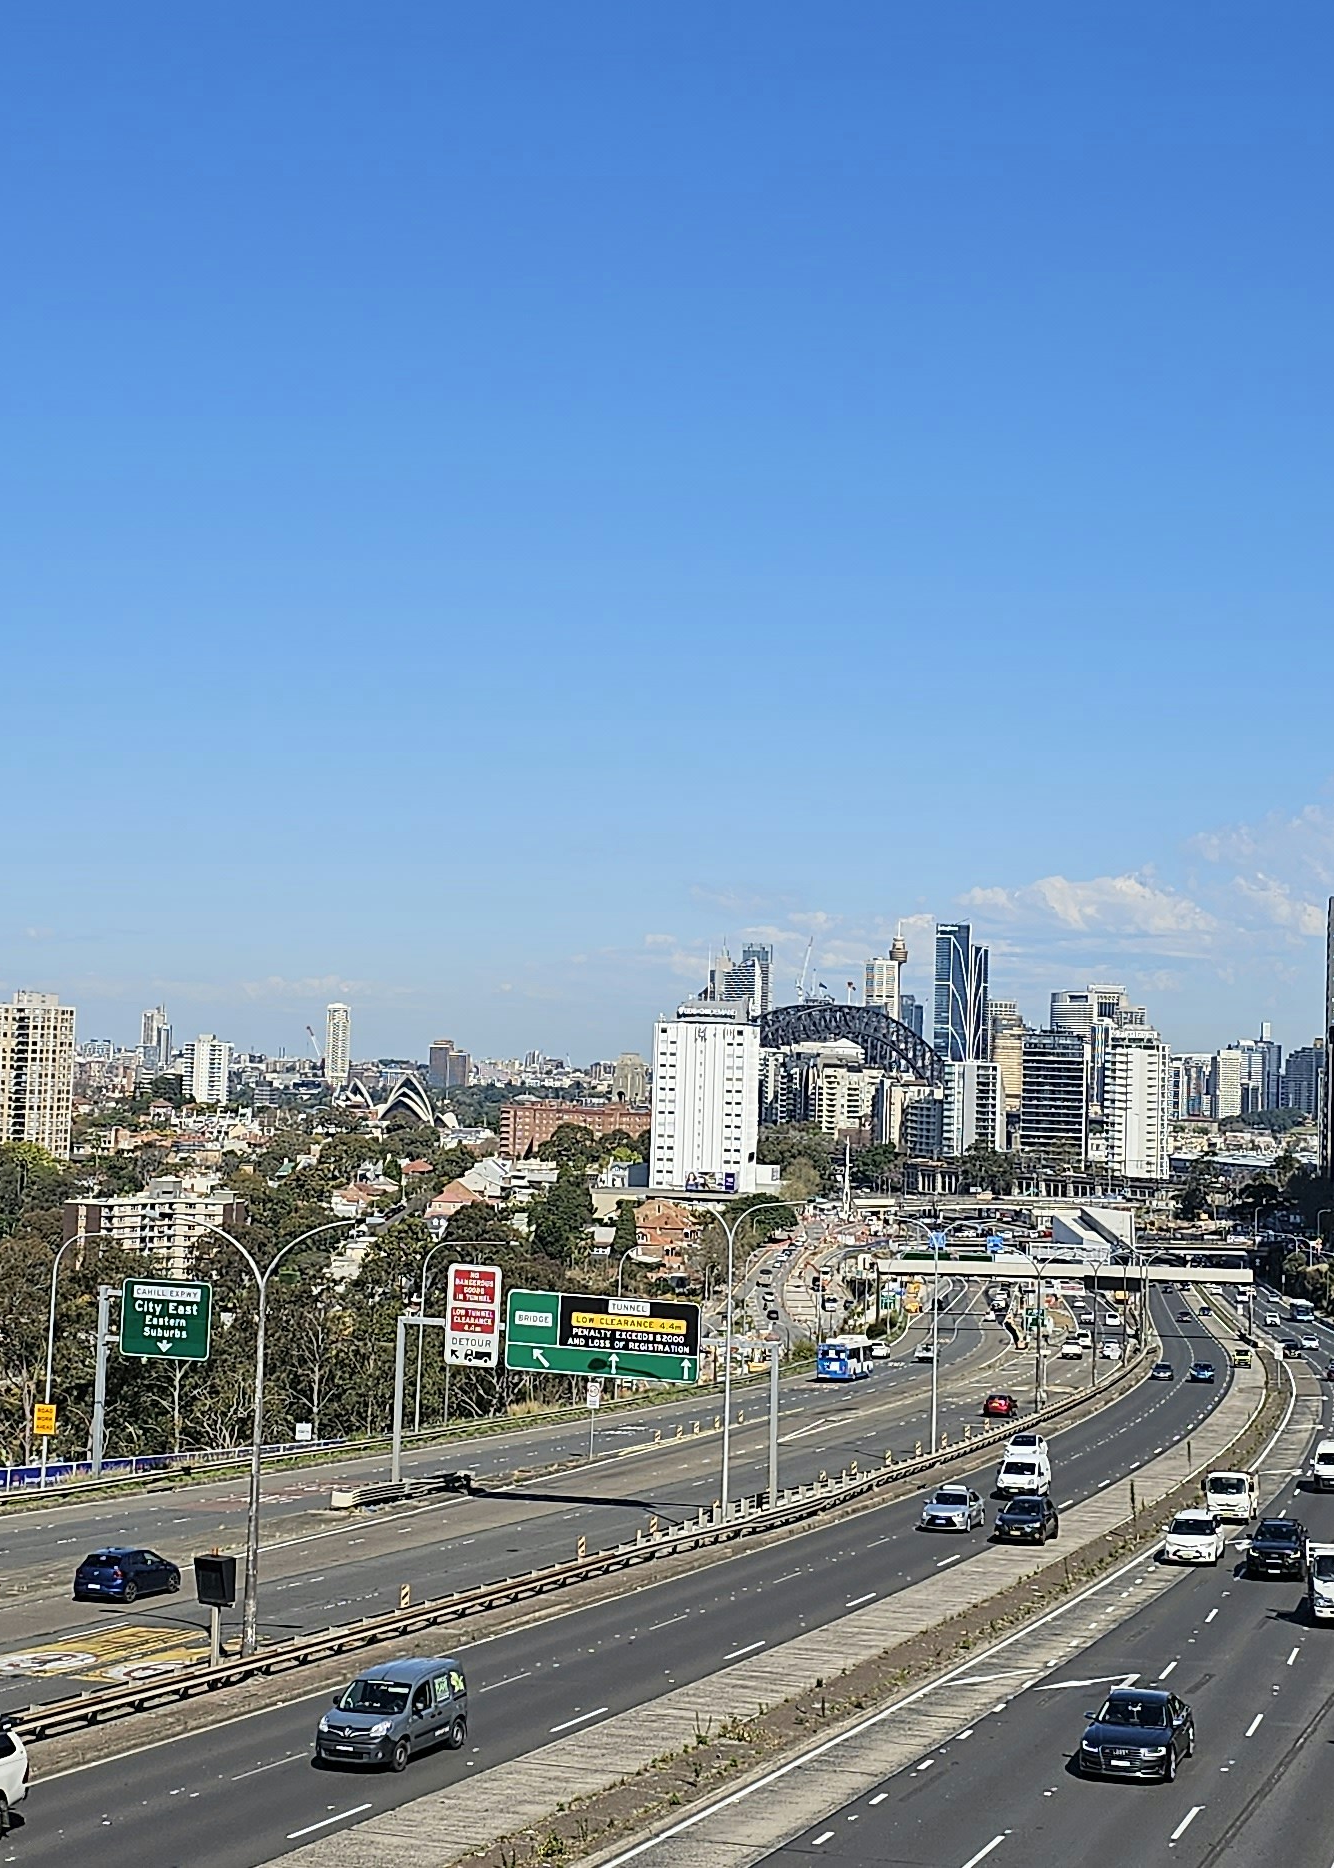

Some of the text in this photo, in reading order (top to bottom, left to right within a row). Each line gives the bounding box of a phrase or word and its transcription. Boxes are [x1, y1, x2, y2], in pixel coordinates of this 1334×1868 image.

[136, 1287, 198, 1298] CAHILL EXPWY
[466, 1294, 492, 1302] TUNNEL
[134, 1300, 198, 1315] City East
[452, 1308, 494, 1318] LOW TUNNEL
[611, 1302, 648, 1313] TUNNEL
[145, 1315, 186, 1326] Eastern
[453, 1316, 492, 1325] CLEARANCE
[518, 1314, 550, 1324] BRIDGE
[576, 1315, 682, 1331] LOW CLEARANCE 4.4m
[143, 1326, 187, 1338] Suburbs
[572, 1328, 685, 1344] PENALTY EXCEEDS $2000
[452, 1337, 492, 1347] DETOUR
[567, 1337, 690, 1353] AND LOSS OF REGISTRATION
